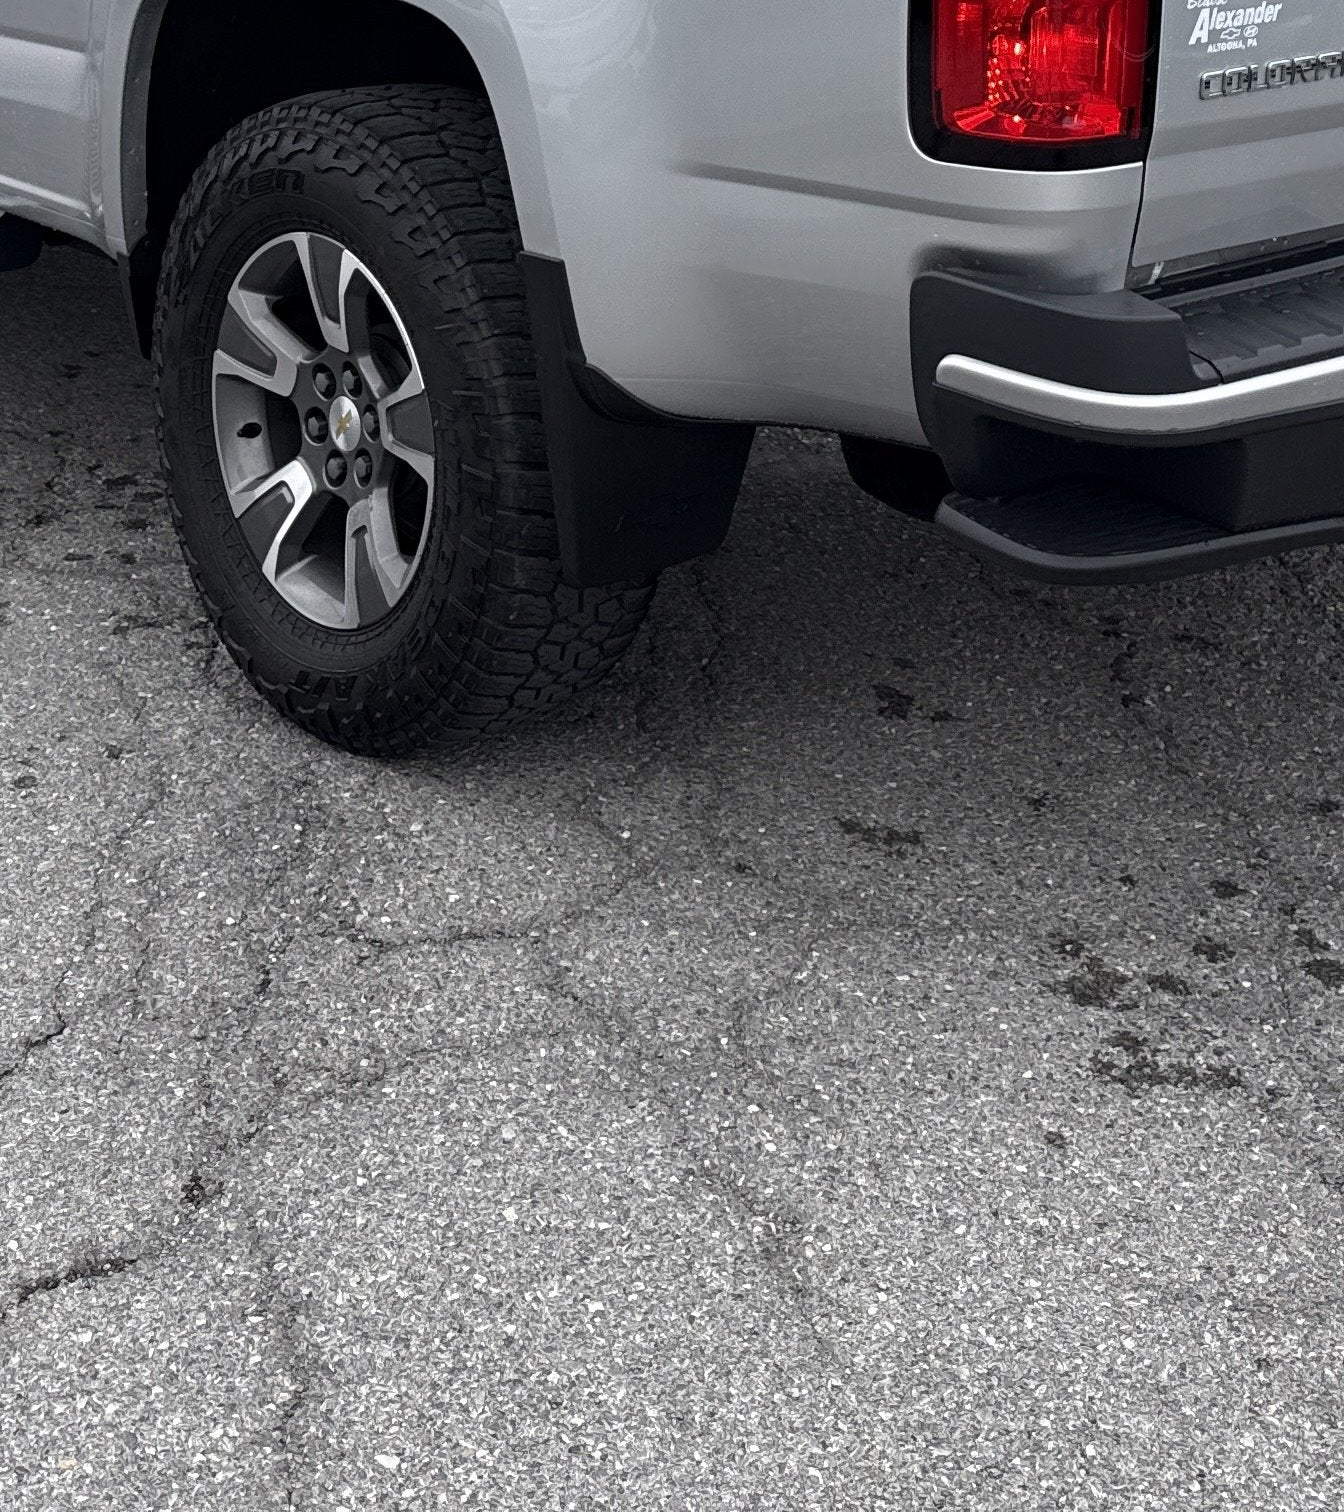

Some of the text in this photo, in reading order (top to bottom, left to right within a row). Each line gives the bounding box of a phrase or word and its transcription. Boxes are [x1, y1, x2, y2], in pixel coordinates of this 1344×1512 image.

[1188, 1, 1283, 45] Alexander
[1206, 38, 1258, 54] ALTOONA, PA
